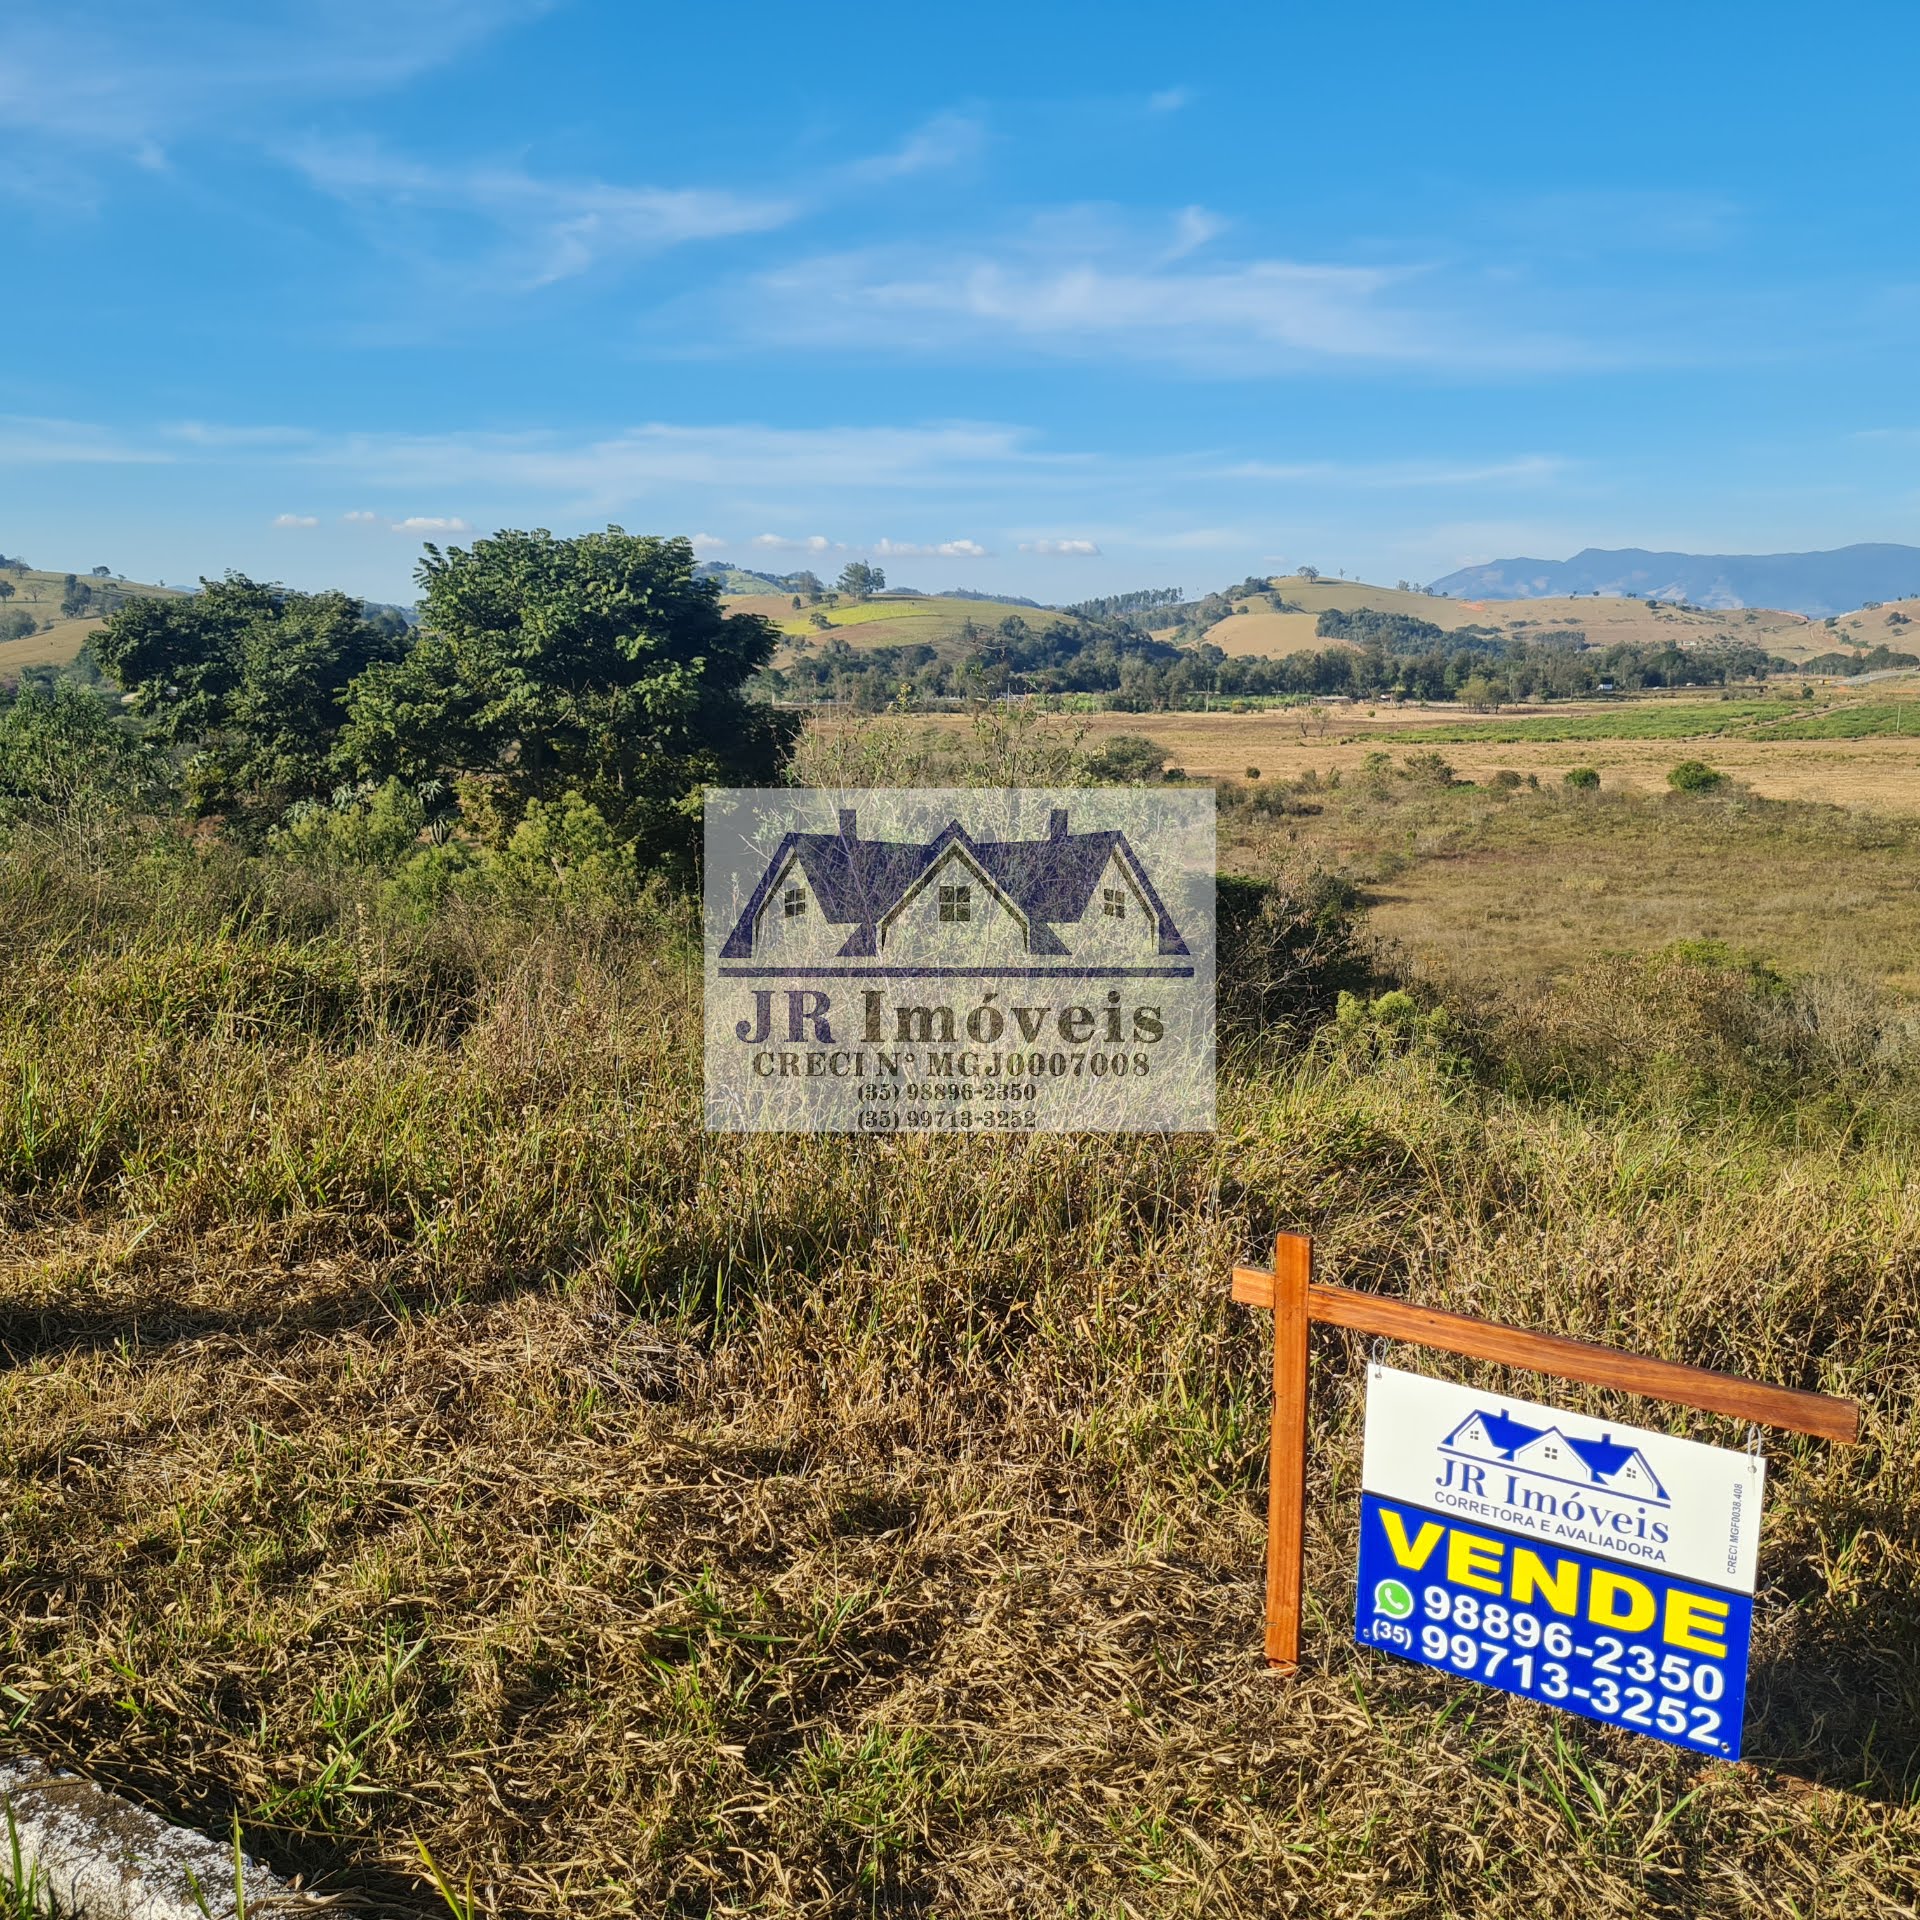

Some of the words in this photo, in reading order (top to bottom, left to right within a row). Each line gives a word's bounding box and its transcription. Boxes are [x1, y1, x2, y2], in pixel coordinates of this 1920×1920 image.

[1434, 1491, 1535, 1530] CORRETORA
[1540, 1517, 1551, 1533] E
[1555, 1522, 1667, 1562] AVALIADORA
[1435, 1457, 1489, 1498] JR
[1504, 1474, 1670, 1544] Imóveis
[1378, 1508, 1730, 1659] VENDE
[1727, 1545, 1738, 1574] CRECI
[1372, 1618, 1412, 1650] (35)
[1421, 1624, 1722, 1748] 99713-3252
[1423, 1585, 1725, 1702] 98896-2350
